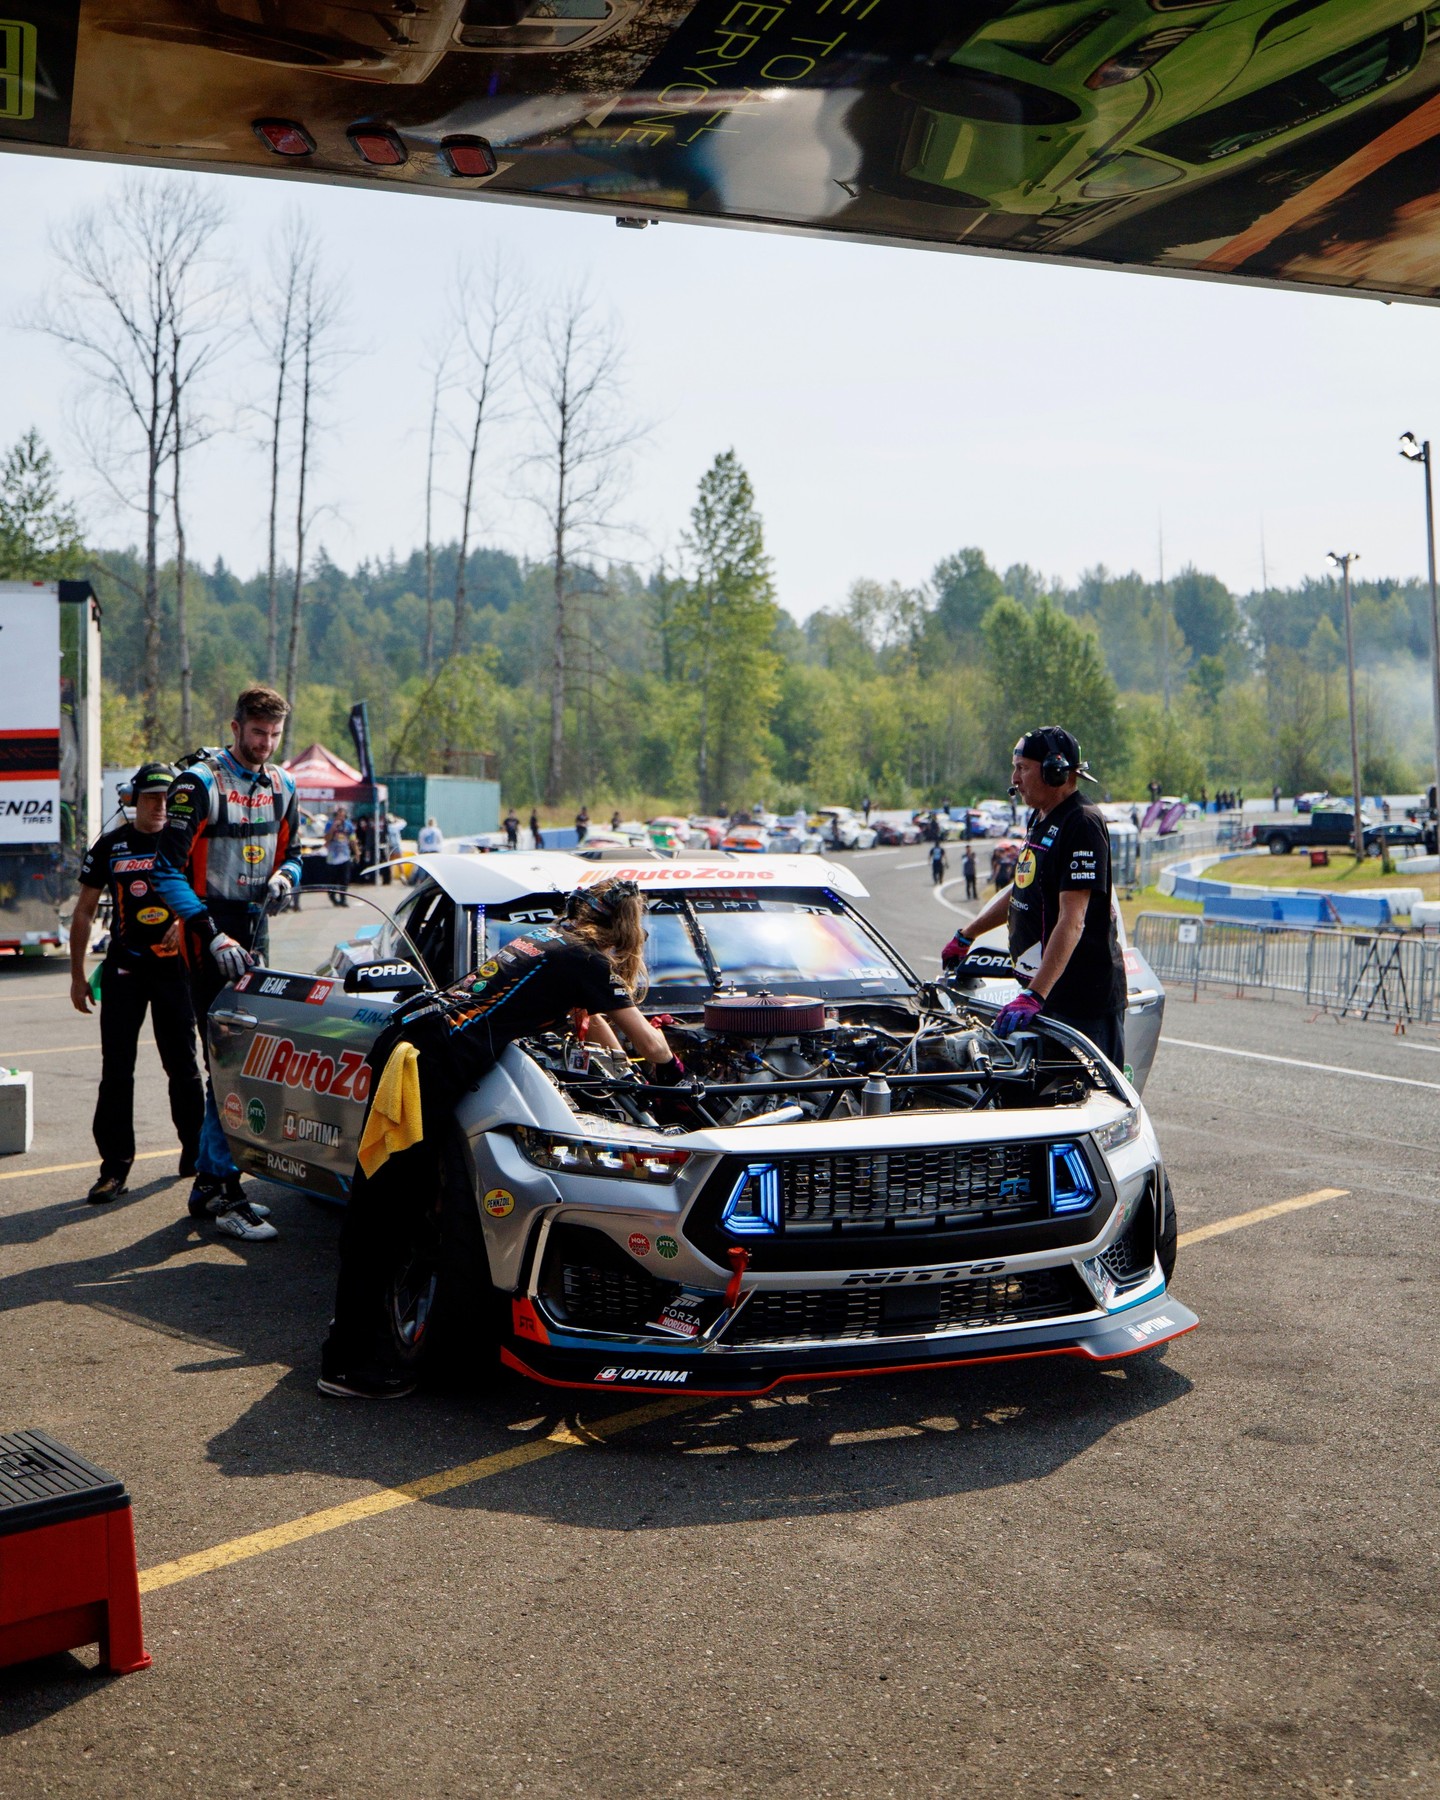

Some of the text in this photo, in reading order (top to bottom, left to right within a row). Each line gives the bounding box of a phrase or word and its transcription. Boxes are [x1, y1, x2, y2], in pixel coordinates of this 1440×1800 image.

[760, 31, 848, 81] TO
[23, 817, 53, 826] TIRES
[614, 867, 776, 882] AutoZone
[357, 964, 412, 982] FORD
[848, 967, 899, 980] 130
[259, 976, 290, 996] DEANE
[309, 983, 328, 1001] 130
[250, 1106, 264, 1117] NTK
[298, 1118, 340, 1148] OPTIMA
[267, 1153, 307, 1179] RACING
[486, 1197, 511, 1208] PENNZOIL
[630, 1237, 647, 1245] NGK
[659, 1240, 675, 1248] NTK
[841, 1260, 1007, 1286] NITTO
[661, 1306, 701, 1327] FORZA
[661, 1316, 695, 1334] HORIZON
[1136, 1315, 1176, 1335] OPTIMA
[620, 1368, 689, 1383] OPTIMA
